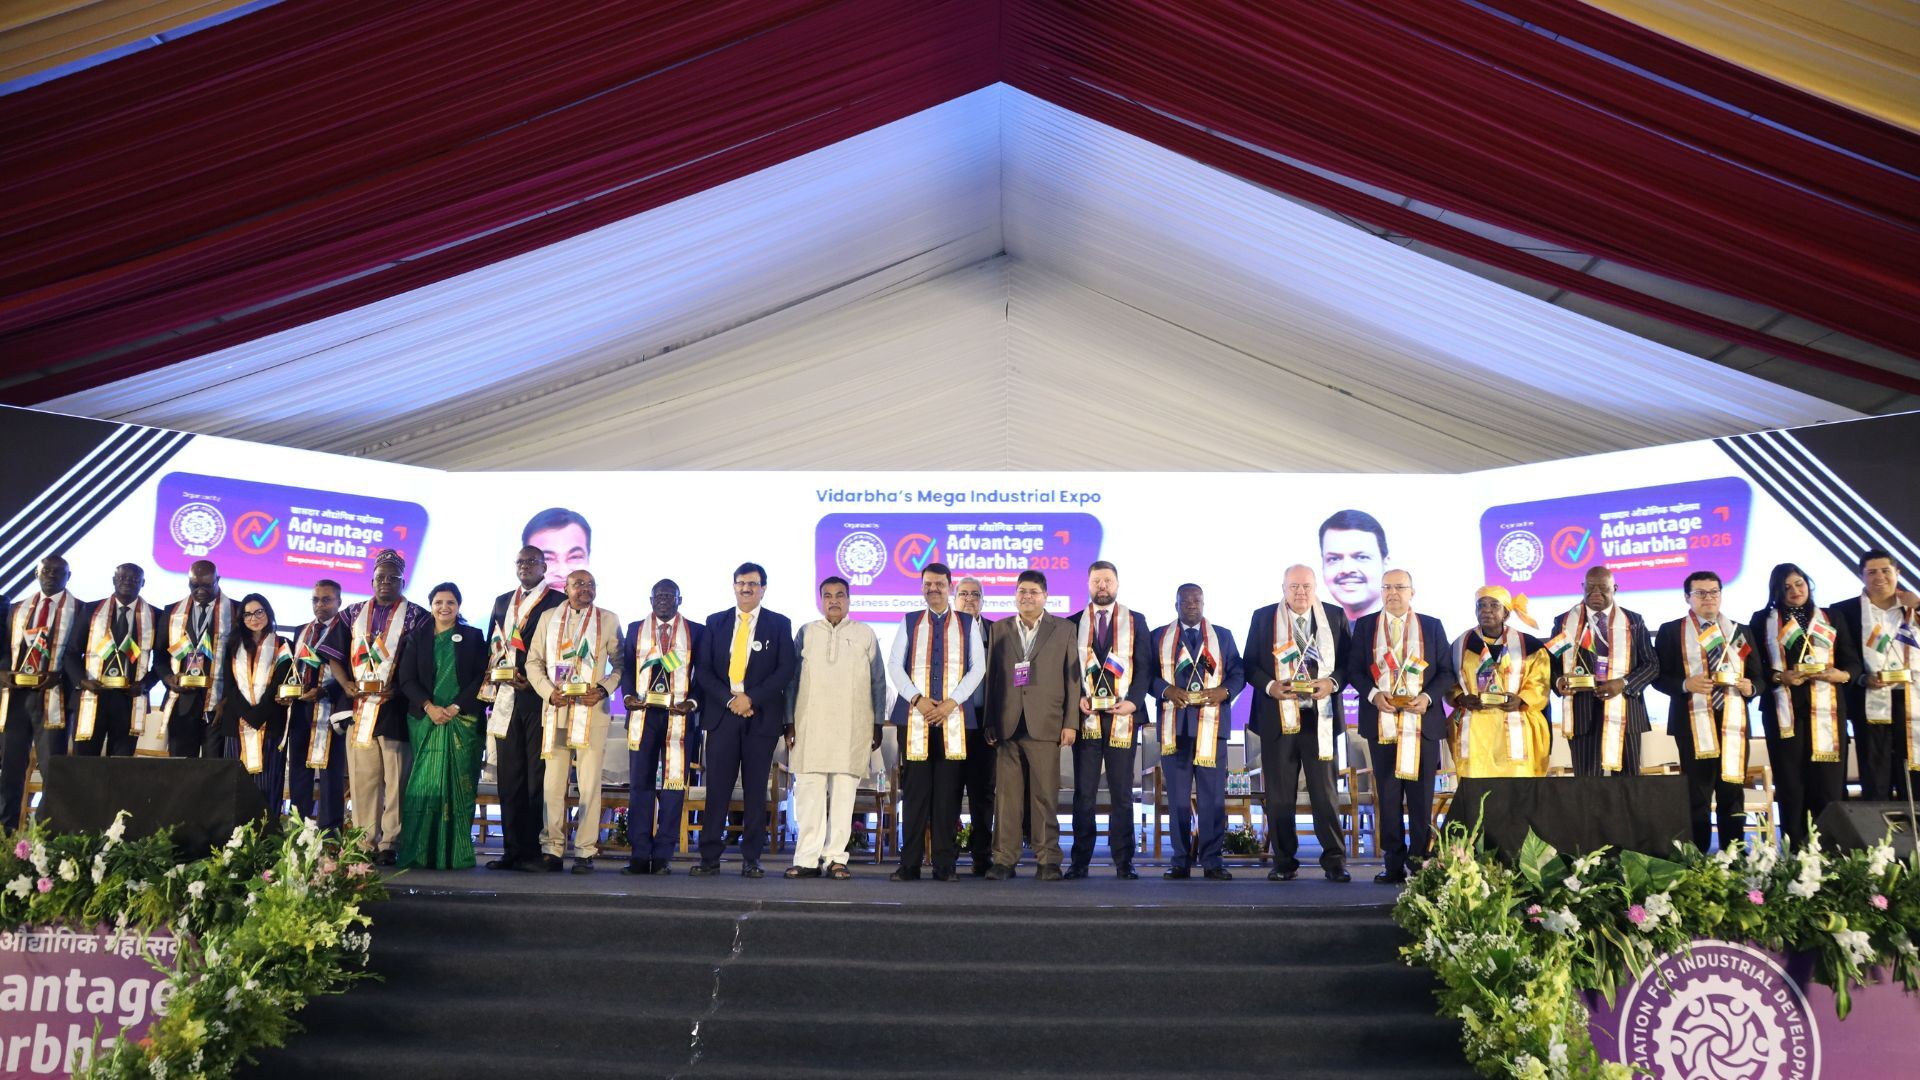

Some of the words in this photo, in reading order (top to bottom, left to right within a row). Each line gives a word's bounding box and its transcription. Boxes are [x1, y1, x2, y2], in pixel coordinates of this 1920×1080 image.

[917, 490, 966, 507] Mega
[971, 489, 1055, 502] Industrial
[1060, 490, 1102, 507] Expo
[288, 516, 384, 544] Advantage
[1601, 516, 1703, 535] Advantage
[183, 544, 209, 557] AID
[286, 533, 367, 558] Vidarbha
[946, 533, 1044, 554] Advantage
[1601, 535, 1688, 557] Vidarbha
[1688, 533, 1731, 549] 2026
[946, 553, 1028, 569] Vidarbha
[1030, 556, 1070, 570] 2026
[850, 574, 873, 586] AID
[1510, 570, 1532, 582] AID
[850, 598, 890, 608] usiness
[1647, 967, 1678, 1000] FOR
[1677, 953, 1772, 991] INDUSTRIAL
[0, 1023, 117, 1074] rbh
